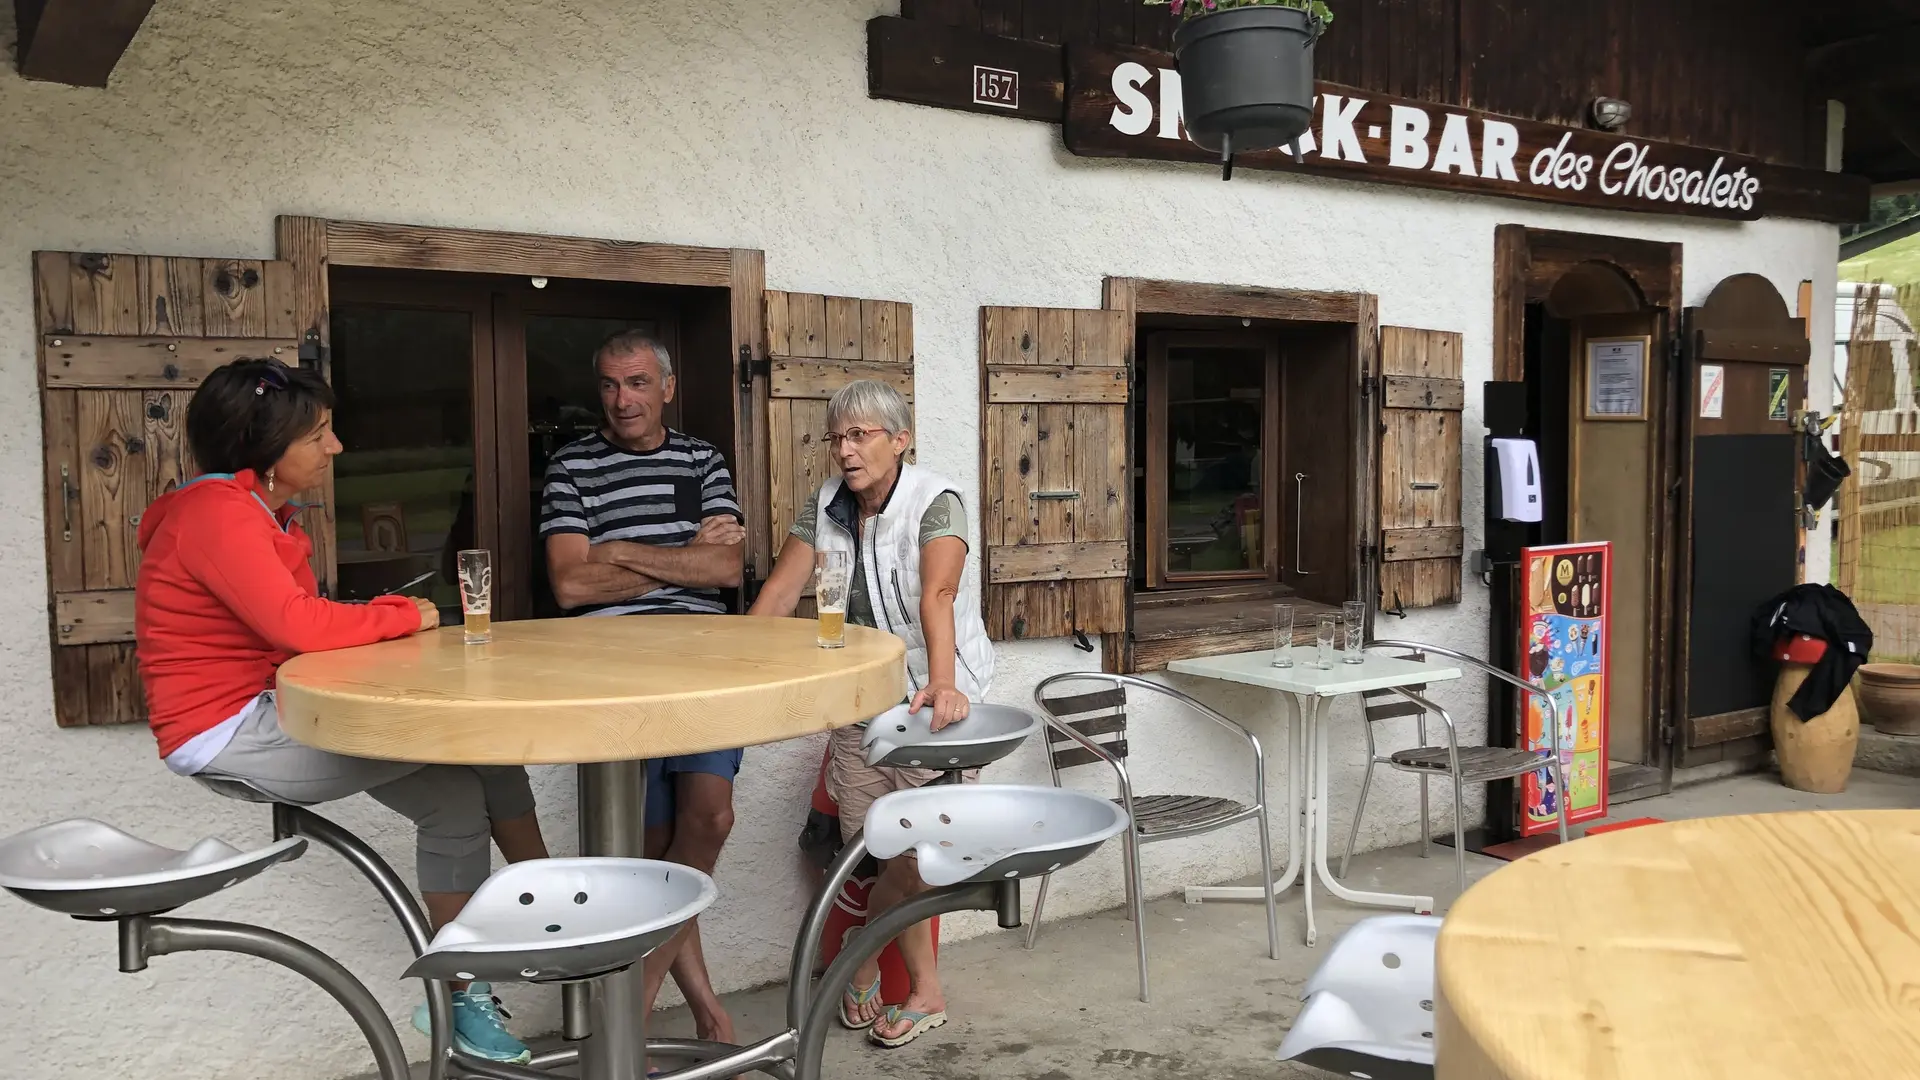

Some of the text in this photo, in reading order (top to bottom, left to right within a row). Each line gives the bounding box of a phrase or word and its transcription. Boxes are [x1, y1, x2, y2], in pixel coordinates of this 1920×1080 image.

[980, 72, 1013, 101] 157
[1109, 61, 1760, 211] SK-BAR des Chosalets
[1560, 564, 1570, 577] M
